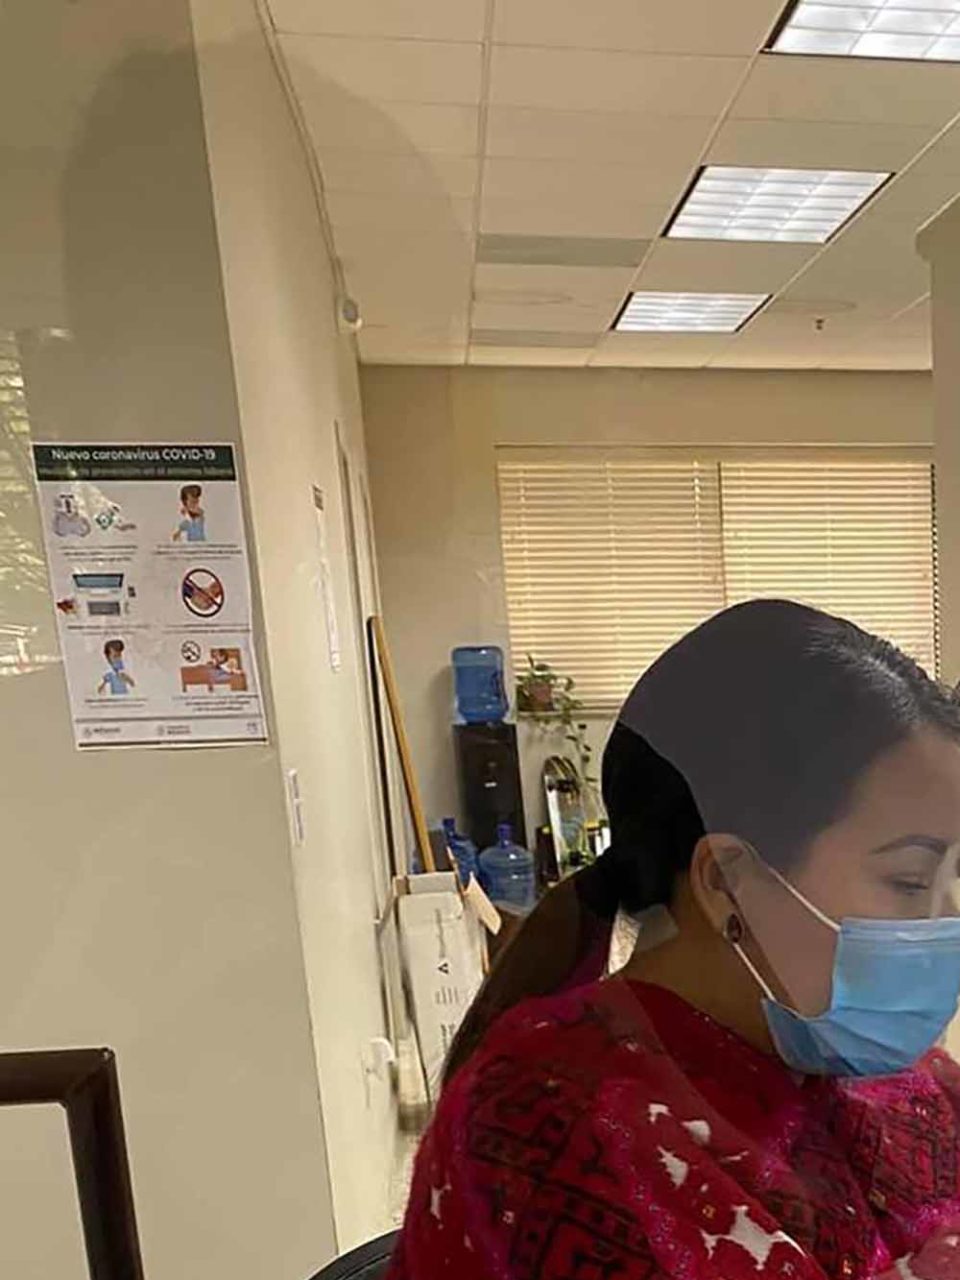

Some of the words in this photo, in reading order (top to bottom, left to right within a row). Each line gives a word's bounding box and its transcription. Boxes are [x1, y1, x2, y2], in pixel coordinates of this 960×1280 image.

[51, 448, 90, 461] Nuevo
[92, 447, 160, 461] coronavirus
[162, 447, 216, 461] COVID-19
